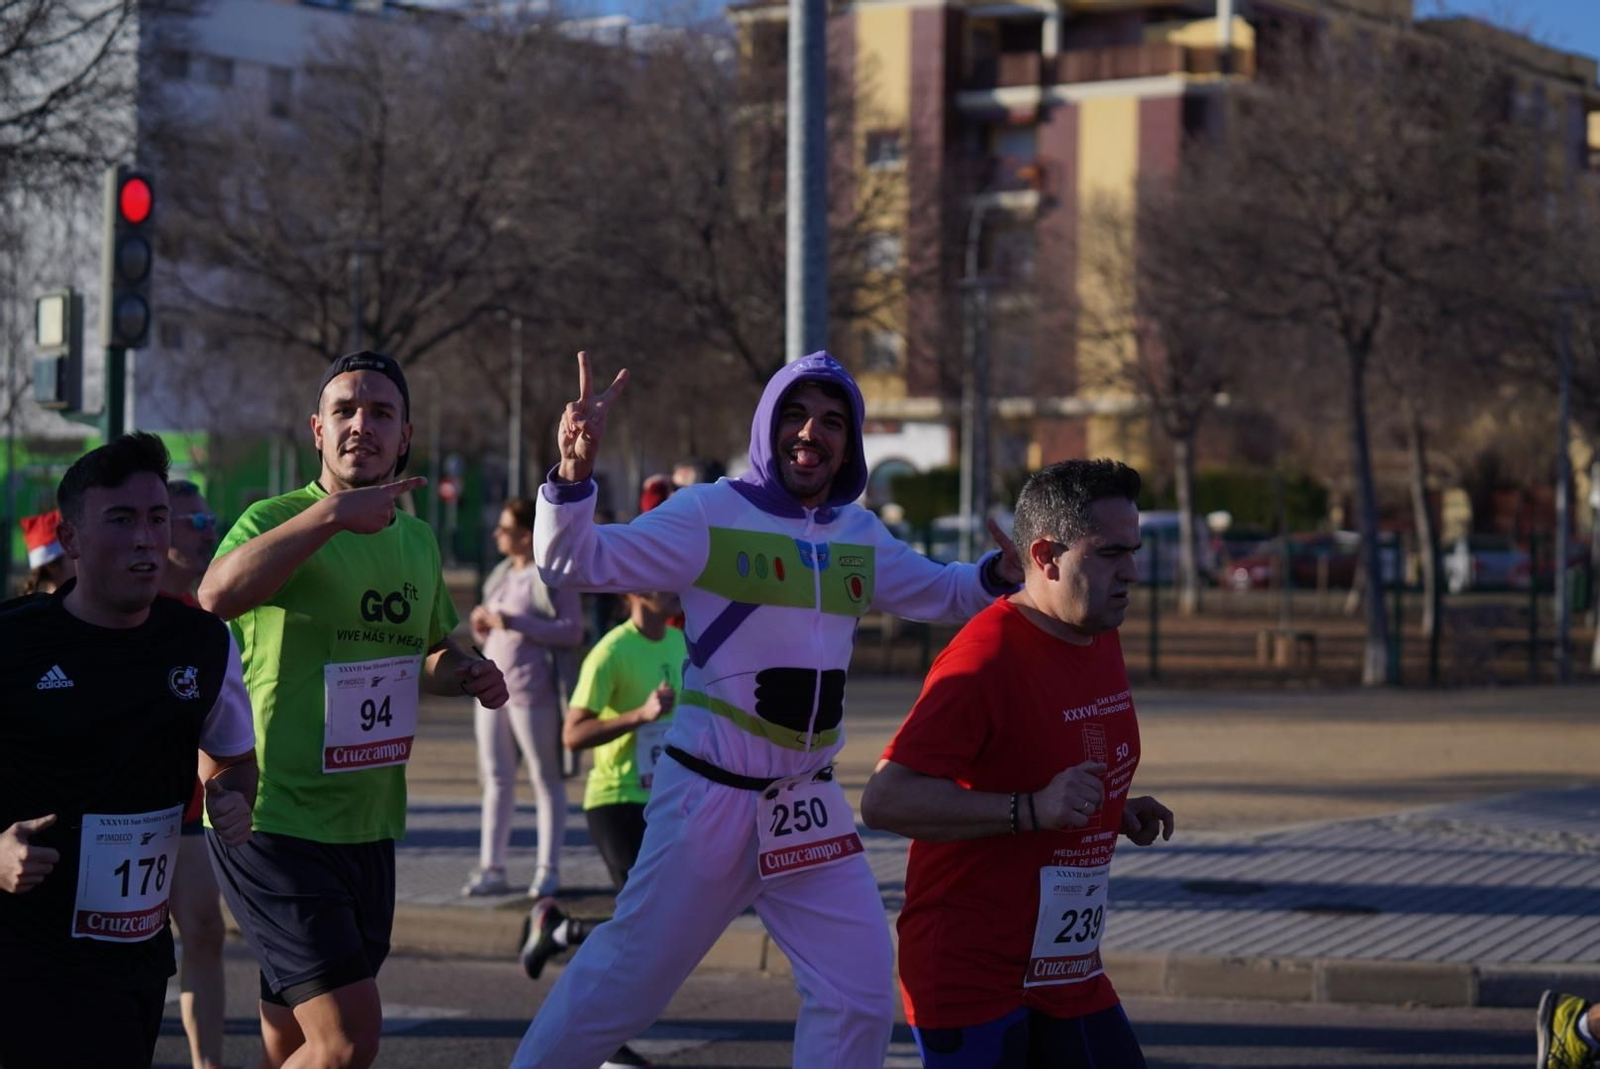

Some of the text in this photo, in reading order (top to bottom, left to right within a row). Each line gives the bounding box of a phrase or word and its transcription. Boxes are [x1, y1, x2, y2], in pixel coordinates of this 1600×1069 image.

[361, 582, 419, 624] GO fit
[336, 629, 361, 642] VIVE
[362, 629, 385, 644] MÁS
[388, 633, 396, 644] Y
[36, 679, 75, 690] adidas
[360, 695, 393, 732] 94
[1062, 704, 1098, 722] XXXVII
[1096, 697, 1109, 706] SAN
[332, 742, 407, 764] Cruzcampo
[1116, 742, 1129, 762] 50
[771, 797, 828, 837] 250
[765, 842, 842, 870] Cruzcampo
[1053, 847, 1091, 857] MEDALLA
[1092, 846, 1100, 855] DE
[114, 853, 168, 898] 178
[1053, 904, 1104, 944] 239
